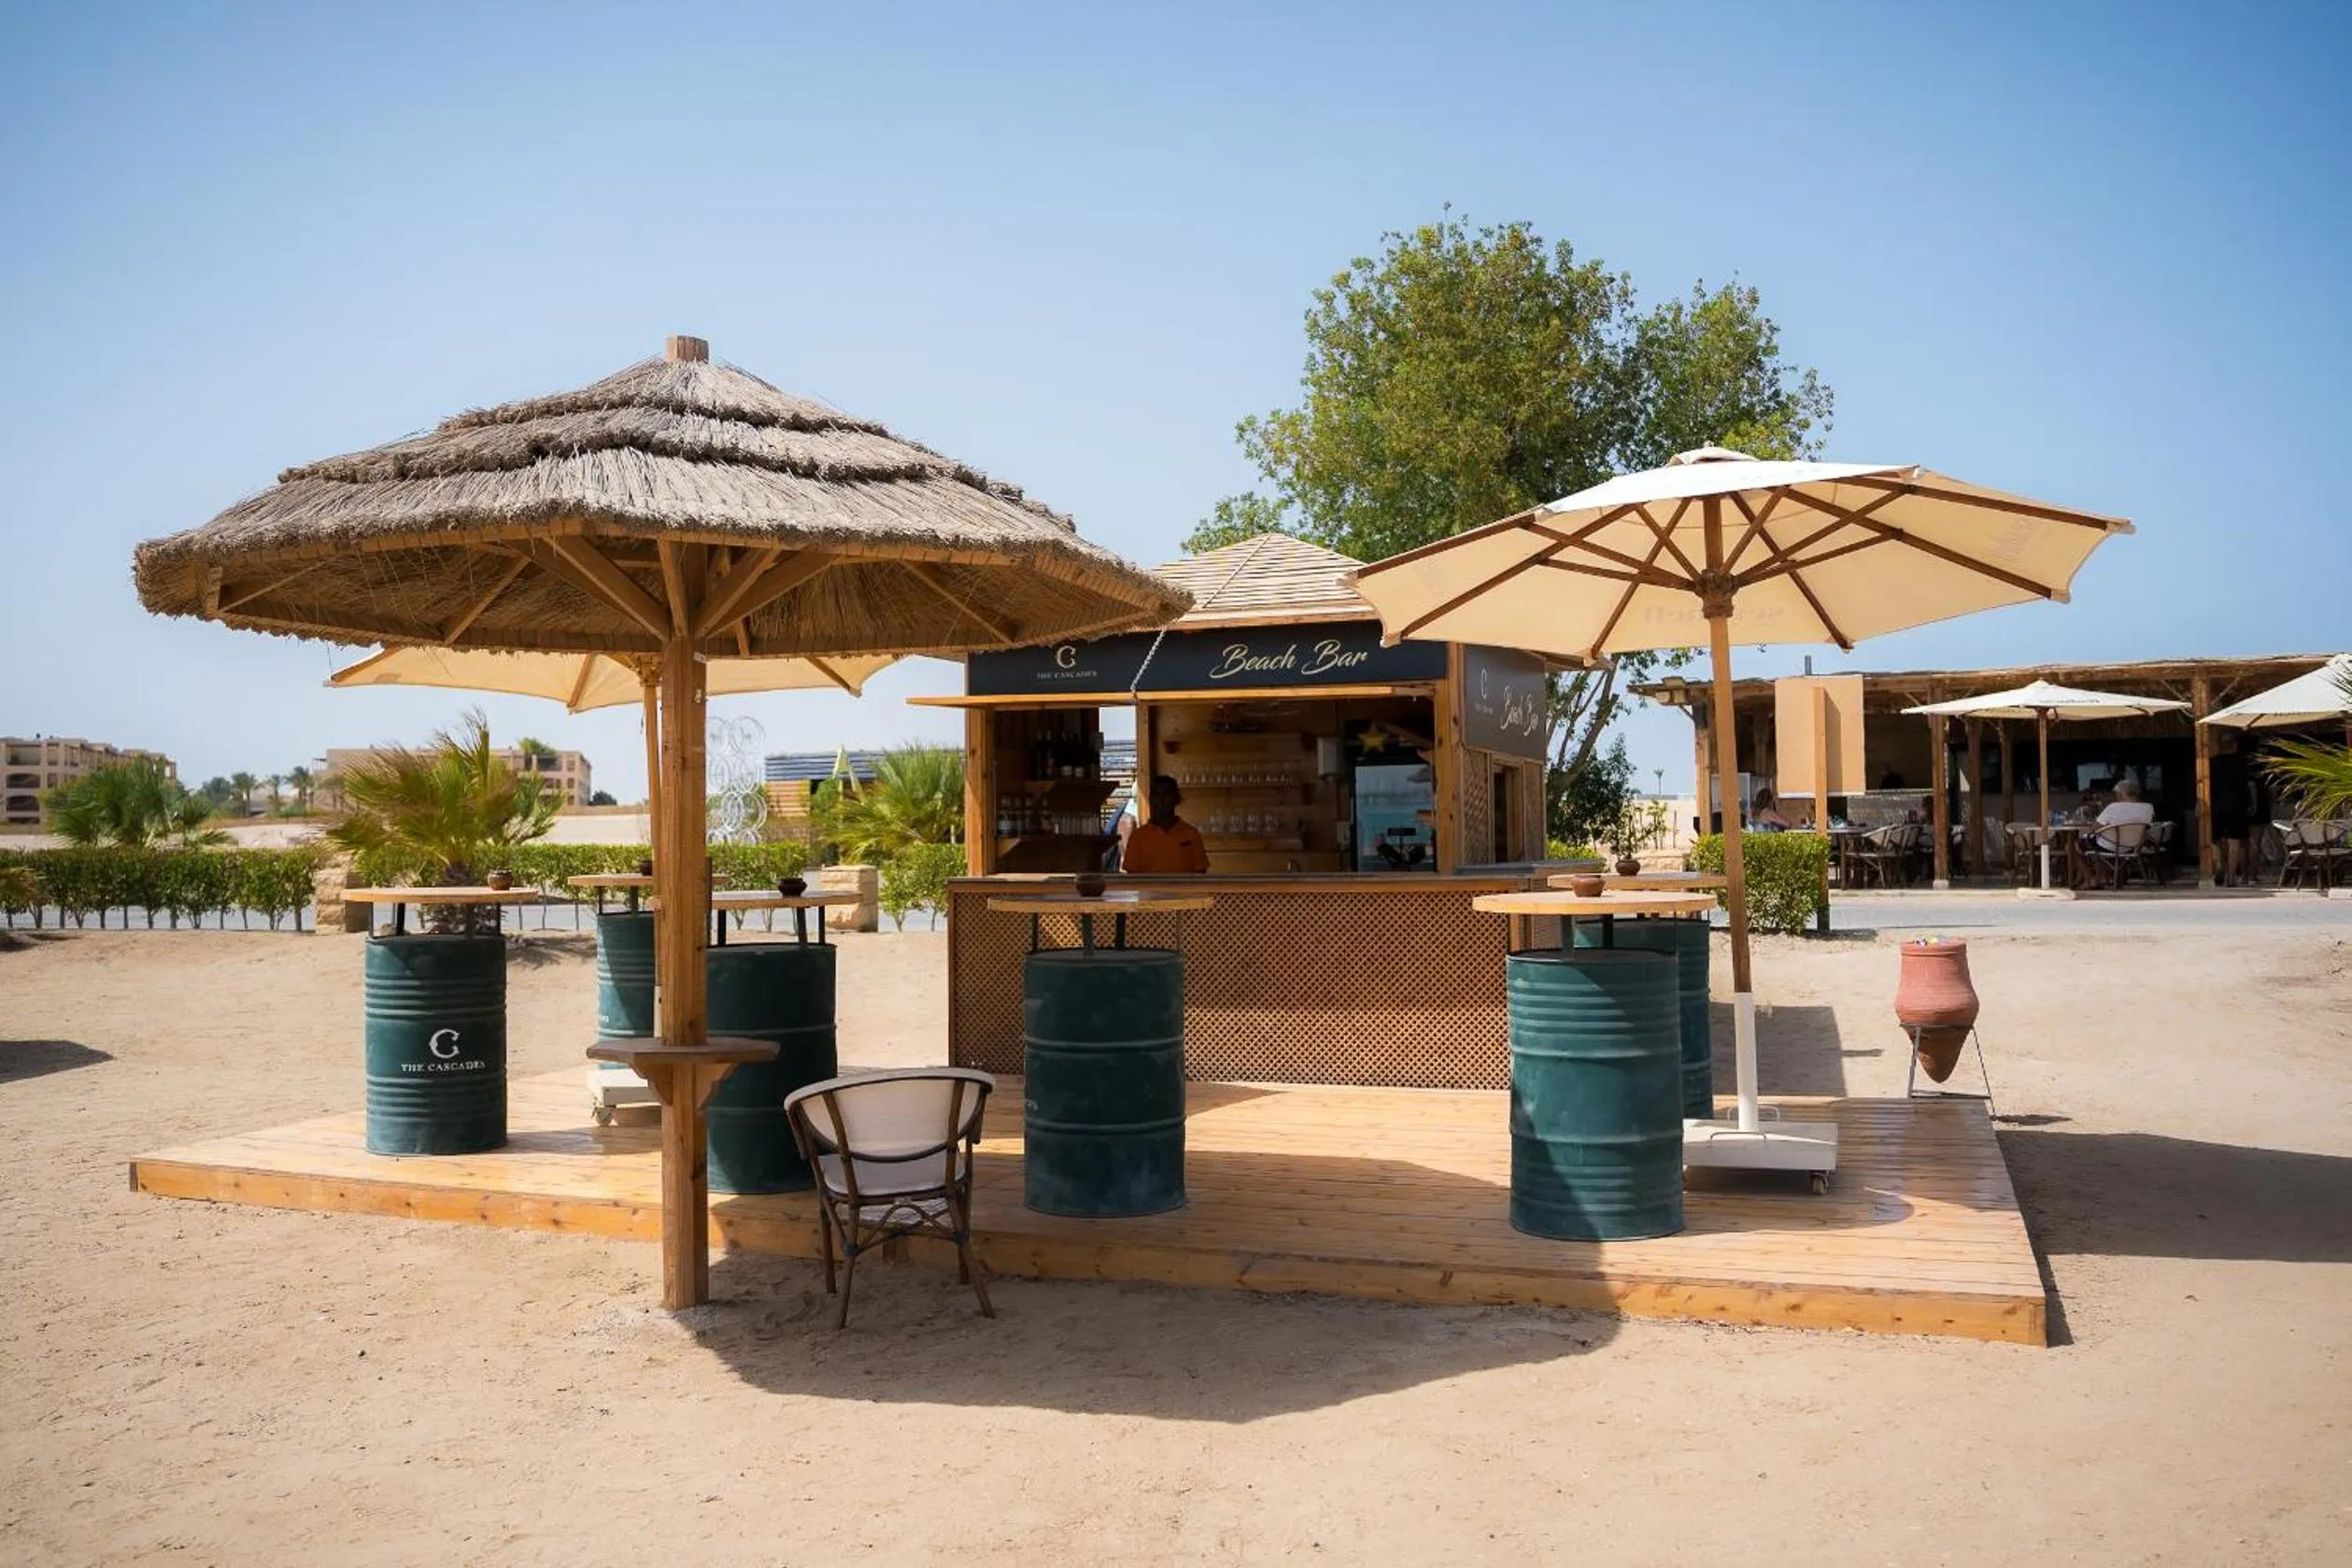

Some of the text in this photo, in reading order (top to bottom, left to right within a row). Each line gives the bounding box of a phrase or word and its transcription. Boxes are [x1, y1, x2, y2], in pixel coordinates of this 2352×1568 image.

[1209, 639, 1368, 679] Beach Bar
[401, 1060, 486, 1072] THE CASCADES
